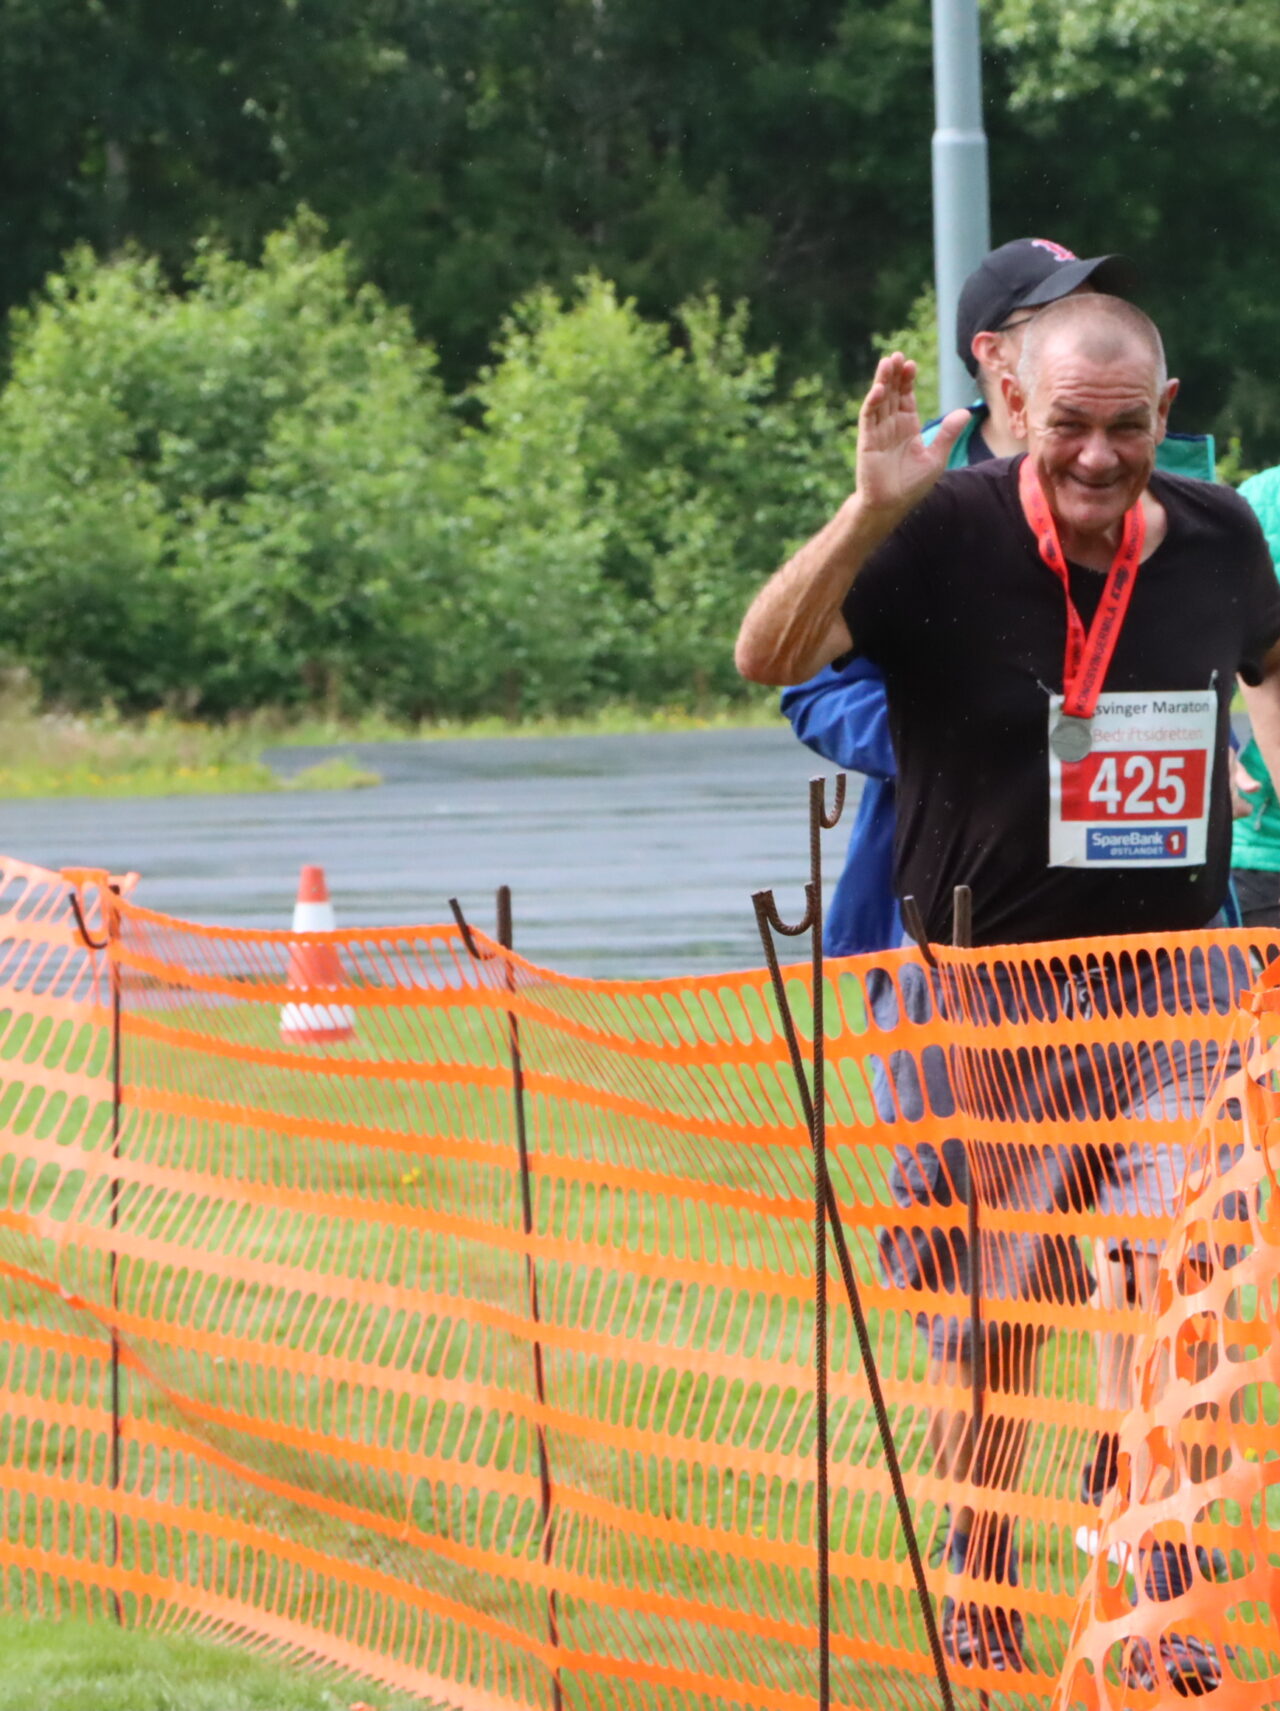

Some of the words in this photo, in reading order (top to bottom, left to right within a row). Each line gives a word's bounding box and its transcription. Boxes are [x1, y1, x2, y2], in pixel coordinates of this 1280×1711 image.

[1152, 701, 1211, 714] Maraton
[1088, 755, 1186, 815] 425
[1091, 831, 1164, 848] SpareBank
